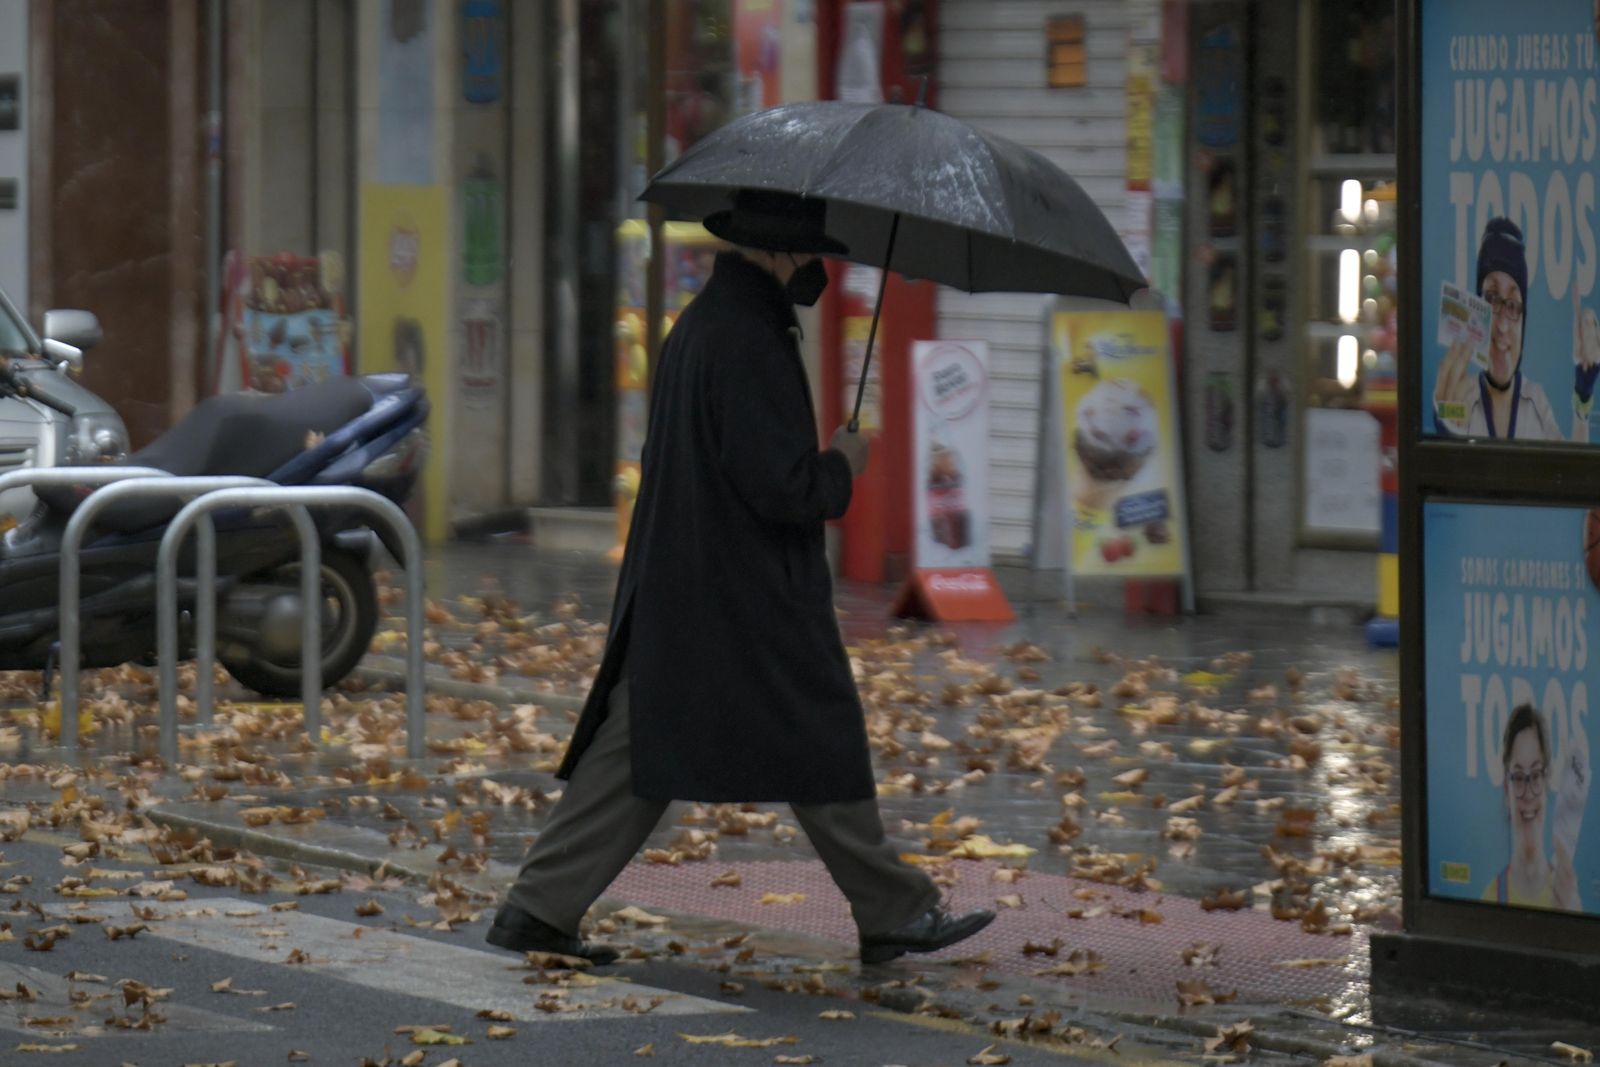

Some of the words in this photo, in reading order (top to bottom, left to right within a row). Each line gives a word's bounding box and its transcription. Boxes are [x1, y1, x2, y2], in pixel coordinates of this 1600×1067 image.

[1450, 34, 1508, 71] CUANDO
[1515, 34, 1568, 71] JUEGAS
[1450, 76, 1597, 164] JUGAMOS
[1461, 557, 1499, 585] SOMOS
[1504, 559, 1571, 591] CAMPEONES
[1460, 592, 1588, 672] JUGAMOS
